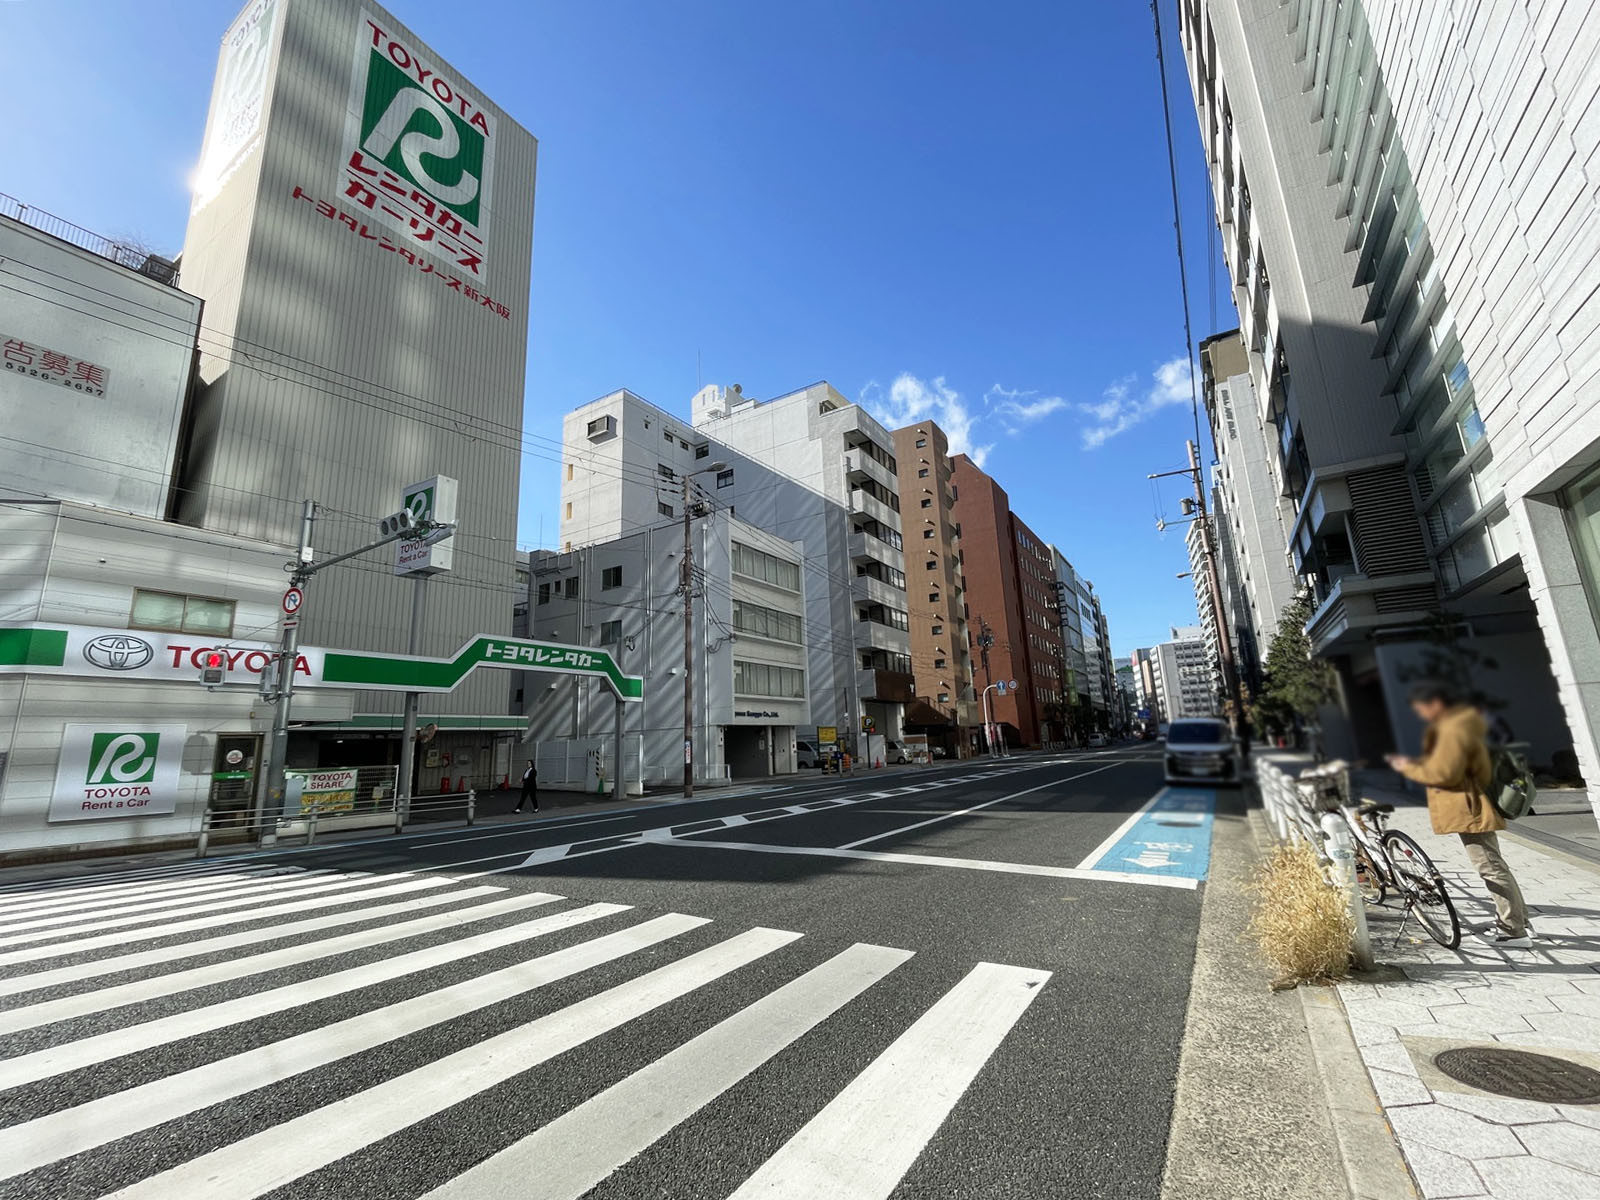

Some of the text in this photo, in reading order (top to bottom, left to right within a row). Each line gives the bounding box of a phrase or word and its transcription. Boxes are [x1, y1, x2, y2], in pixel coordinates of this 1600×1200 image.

[366, 19, 490, 138] TOYOTA
[348, 150, 484, 245] レンタカー
[344, 177, 483, 276] カーリース
[292, 185, 511, 321] トヨタレンタリース新大阪
[485, 643, 603, 668] トヨタレンタカー
[310, 780, 345, 790] SHARE
[311, 771, 353, 782] TOYOTA
[81, 798, 151, 811] Rent a Car
[84, 786, 151, 799] TOYOTA
